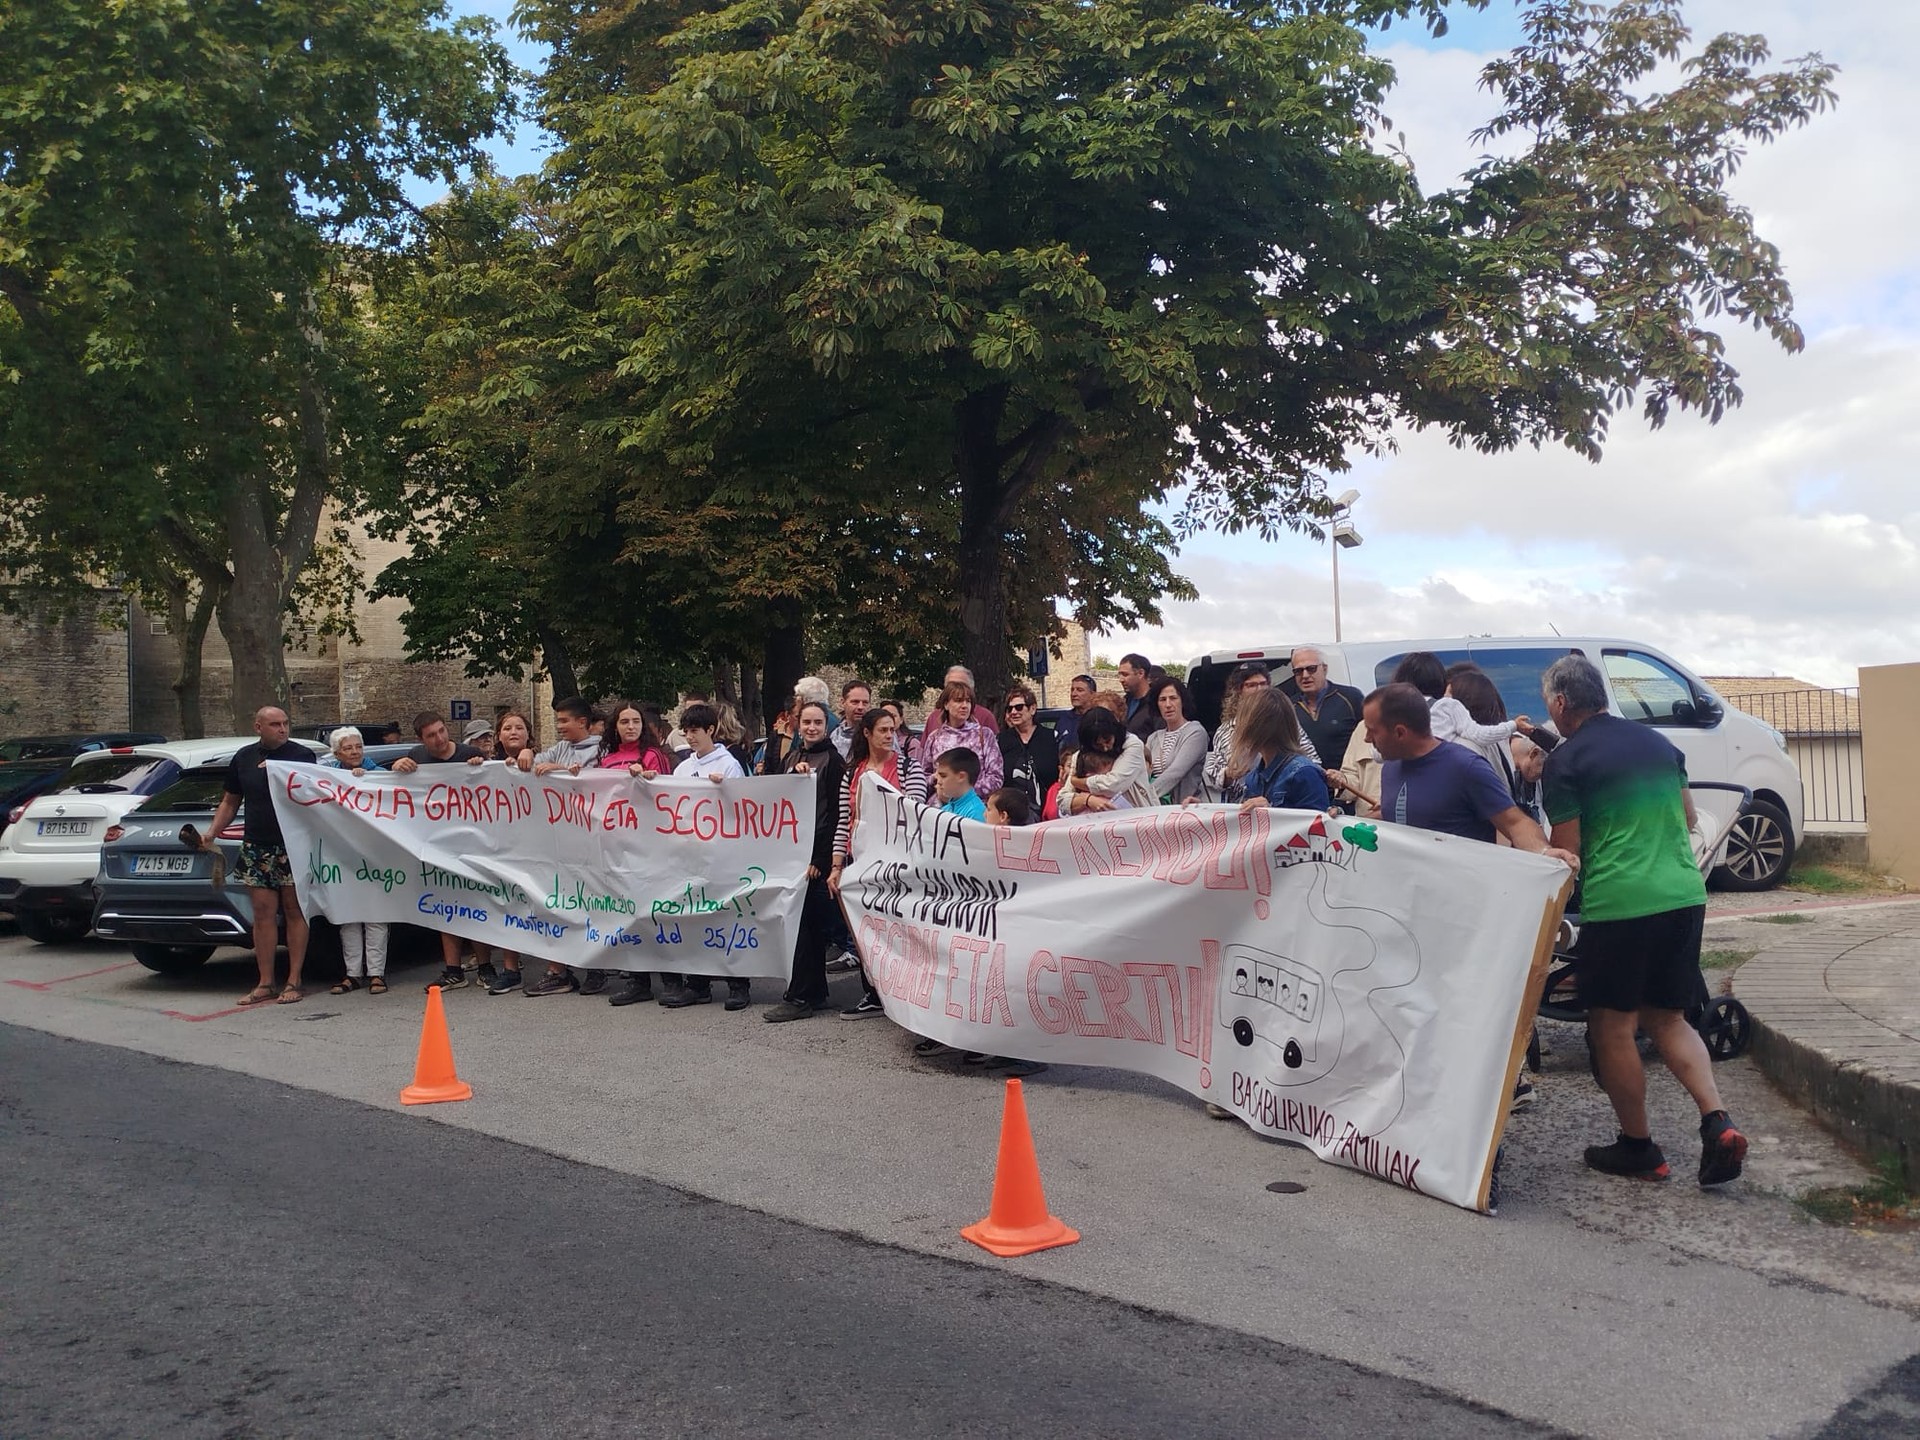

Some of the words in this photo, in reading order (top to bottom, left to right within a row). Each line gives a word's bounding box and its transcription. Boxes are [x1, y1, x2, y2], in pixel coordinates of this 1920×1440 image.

[455, 702, 467, 718] P
[45, 821, 67, 835] 8715
[69, 821, 87, 834] KLD
[287, 771, 415, 820] ESKOLA
[603, 799, 638, 829] ETA
[655, 792, 799, 844] SEGURUA
[138, 856, 163, 871] 7415
[166, 856, 189, 871] MGB
[310, 838, 342, 884] Non
[355, 859, 406, 893] dago
[877, 785, 969, 865] TAXIA
[1069, 807, 1272, 920] KENDU!
[859, 860, 912, 918] GURE
[418, 893, 488, 922] Exigimos
[505, 911, 569, 938] mantener
[585, 917, 600, 942] las
[603, 927, 642, 946] rutas
[656, 922, 682, 944] del
[704, 922, 759, 956] 25/26
[945, 935, 1015, 1027] ETA
[1026, 939, 1220, 1089] GERTU!
[1232, 1072, 1335, 1147] BASABURUKO
[1333, 1121, 1426, 1195] FAMILIAK
